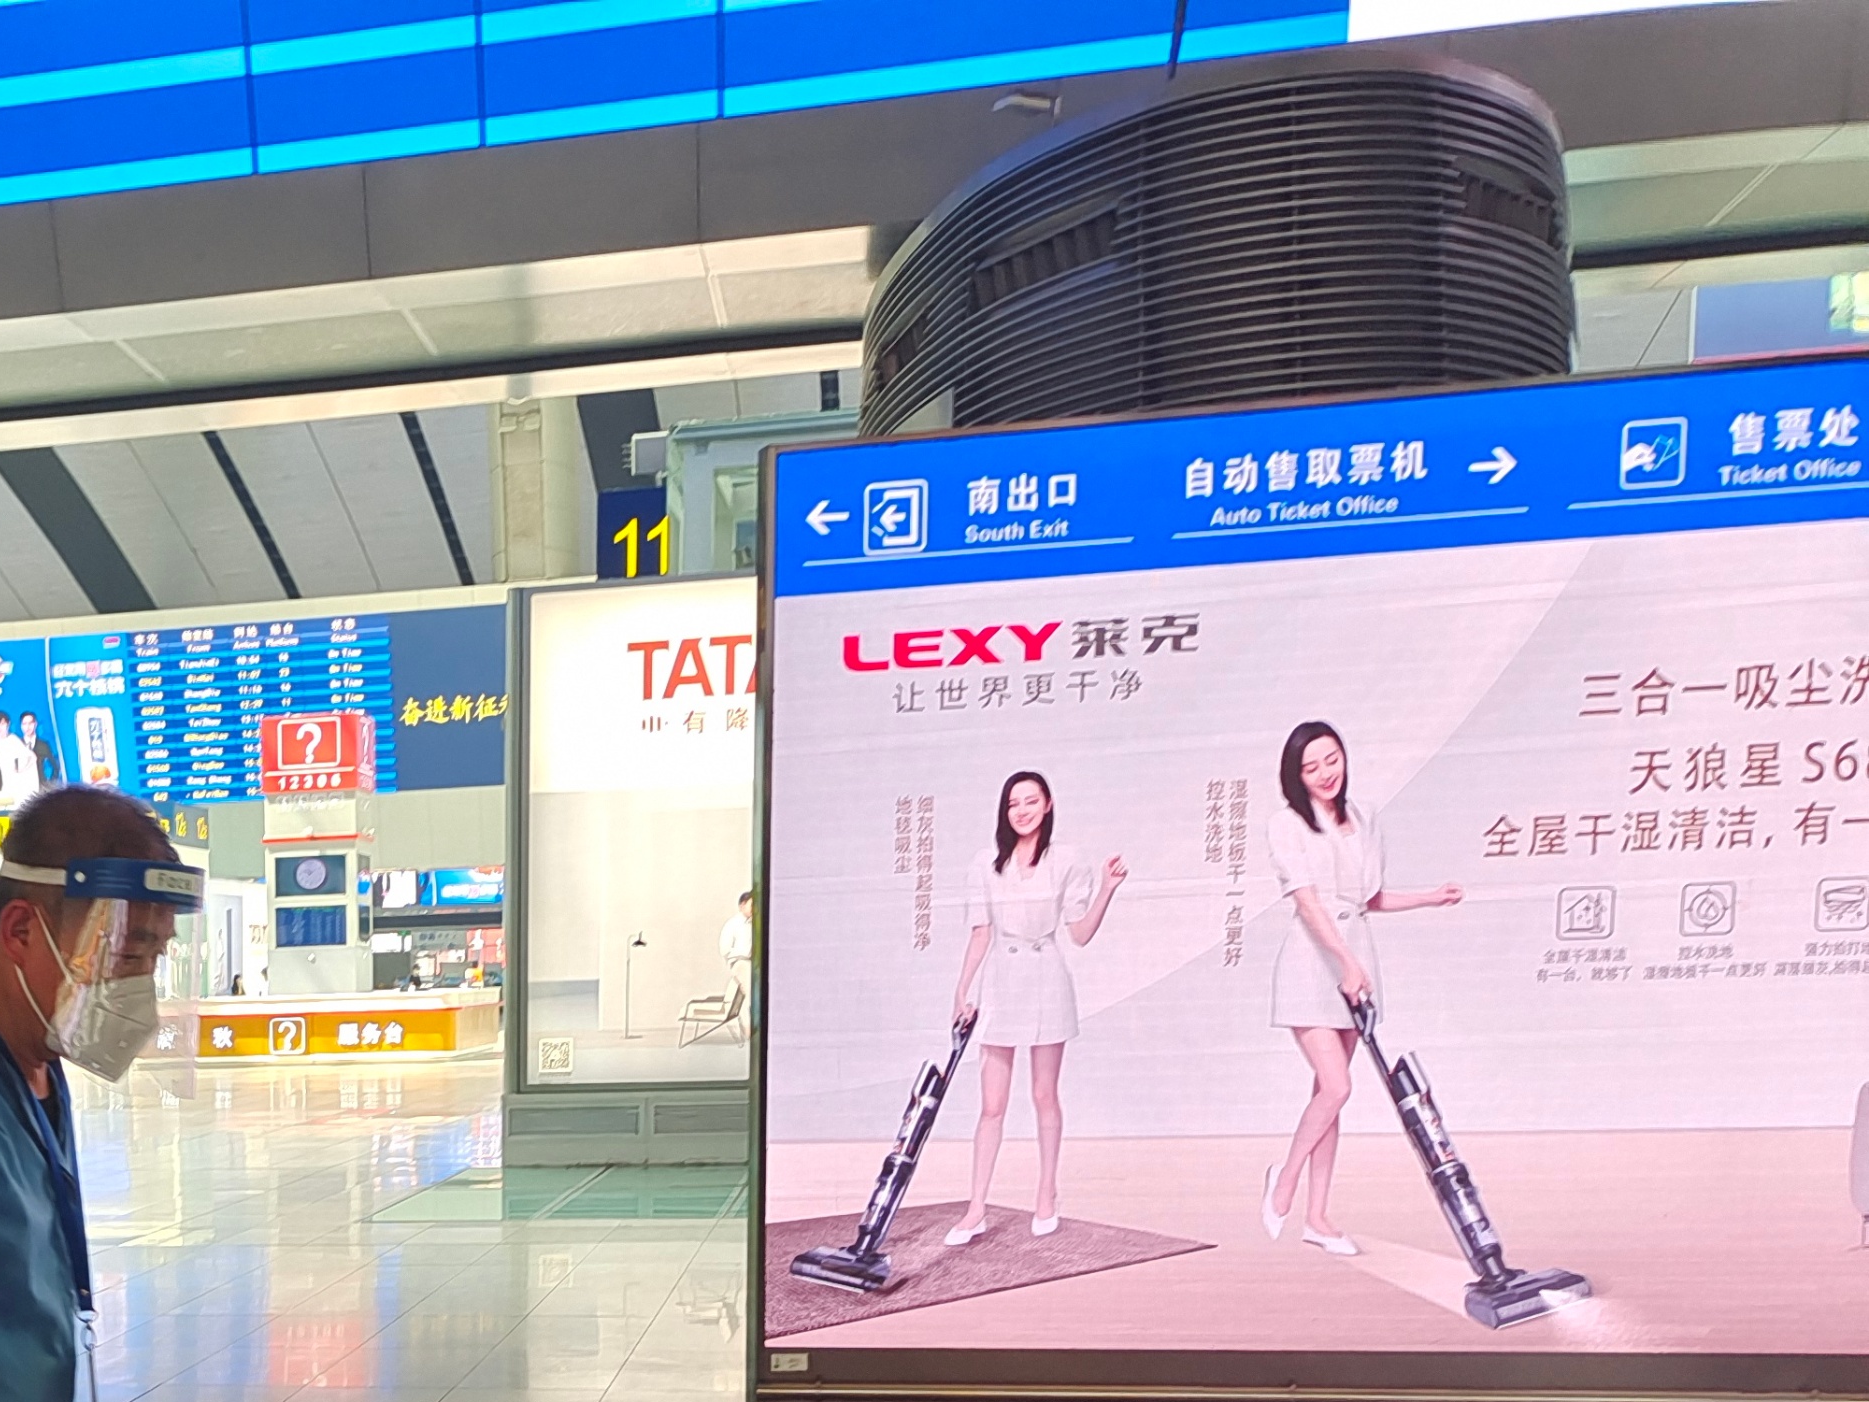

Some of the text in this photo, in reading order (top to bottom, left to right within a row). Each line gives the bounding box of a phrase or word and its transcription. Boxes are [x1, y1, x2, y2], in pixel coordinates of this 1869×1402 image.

[1729, 404, 1860, 456] 售票处
[967, 473, 1078, 515] 南出口
[1184, 440, 1429, 499] 自动售取票机
[1718, 457, 1862, 487] Ticket Office
[964, 518, 1069, 544] South Exit
[1210, 494, 1398, 527] Auto Ticket Office
[613, 514, 671, 578] 11
[842, 612, 1201, 672] LEXY 莱克
[627, 634, 757, 701] TAT
[891, 667, 1143, 714] 让世界更干净
[278, 772, 343, 791] 12306
[1628, 739, 1869, 797] 天狼星 S6
